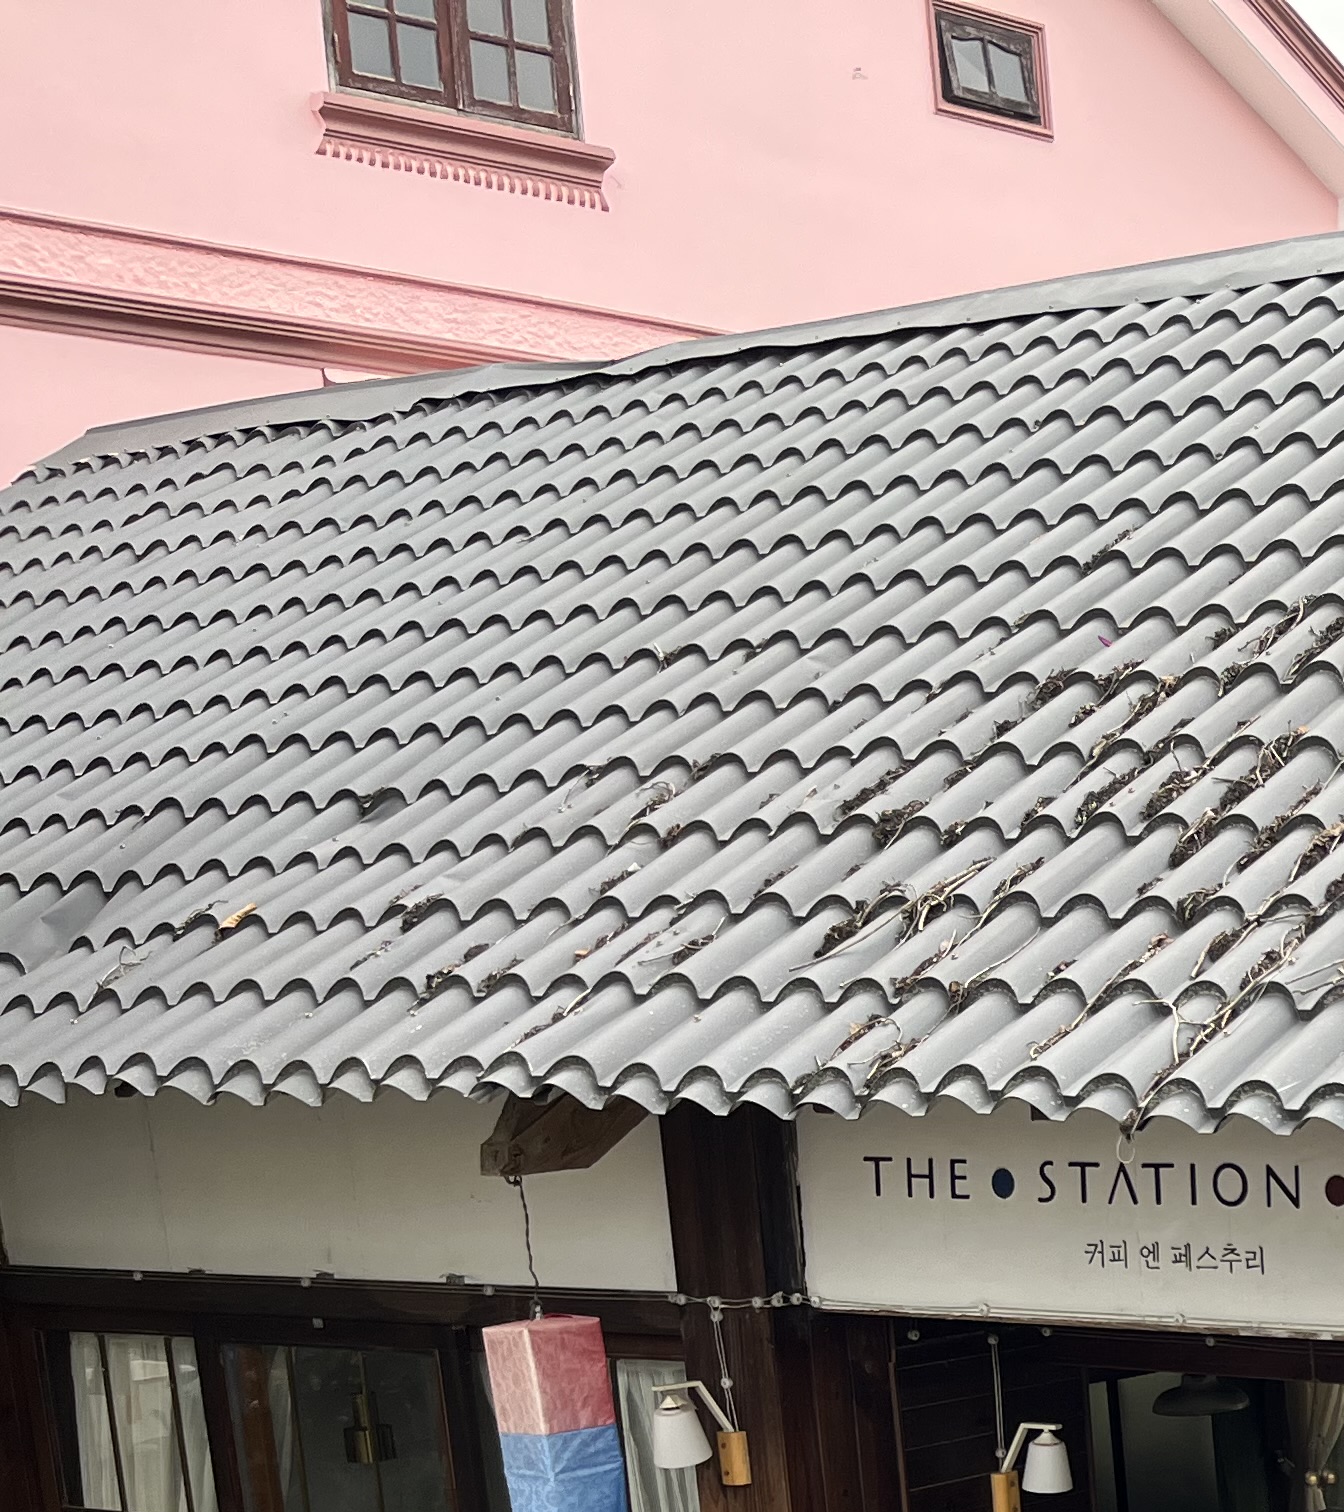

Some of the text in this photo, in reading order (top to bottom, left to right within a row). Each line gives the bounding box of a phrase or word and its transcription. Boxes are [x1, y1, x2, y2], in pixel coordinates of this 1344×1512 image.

[863, 1156, 970, 1200] THE
[1037, 1160, 1300, 1209] STATION
[1084, 1239, 1265, 1276] 커피 엔 페스추리
